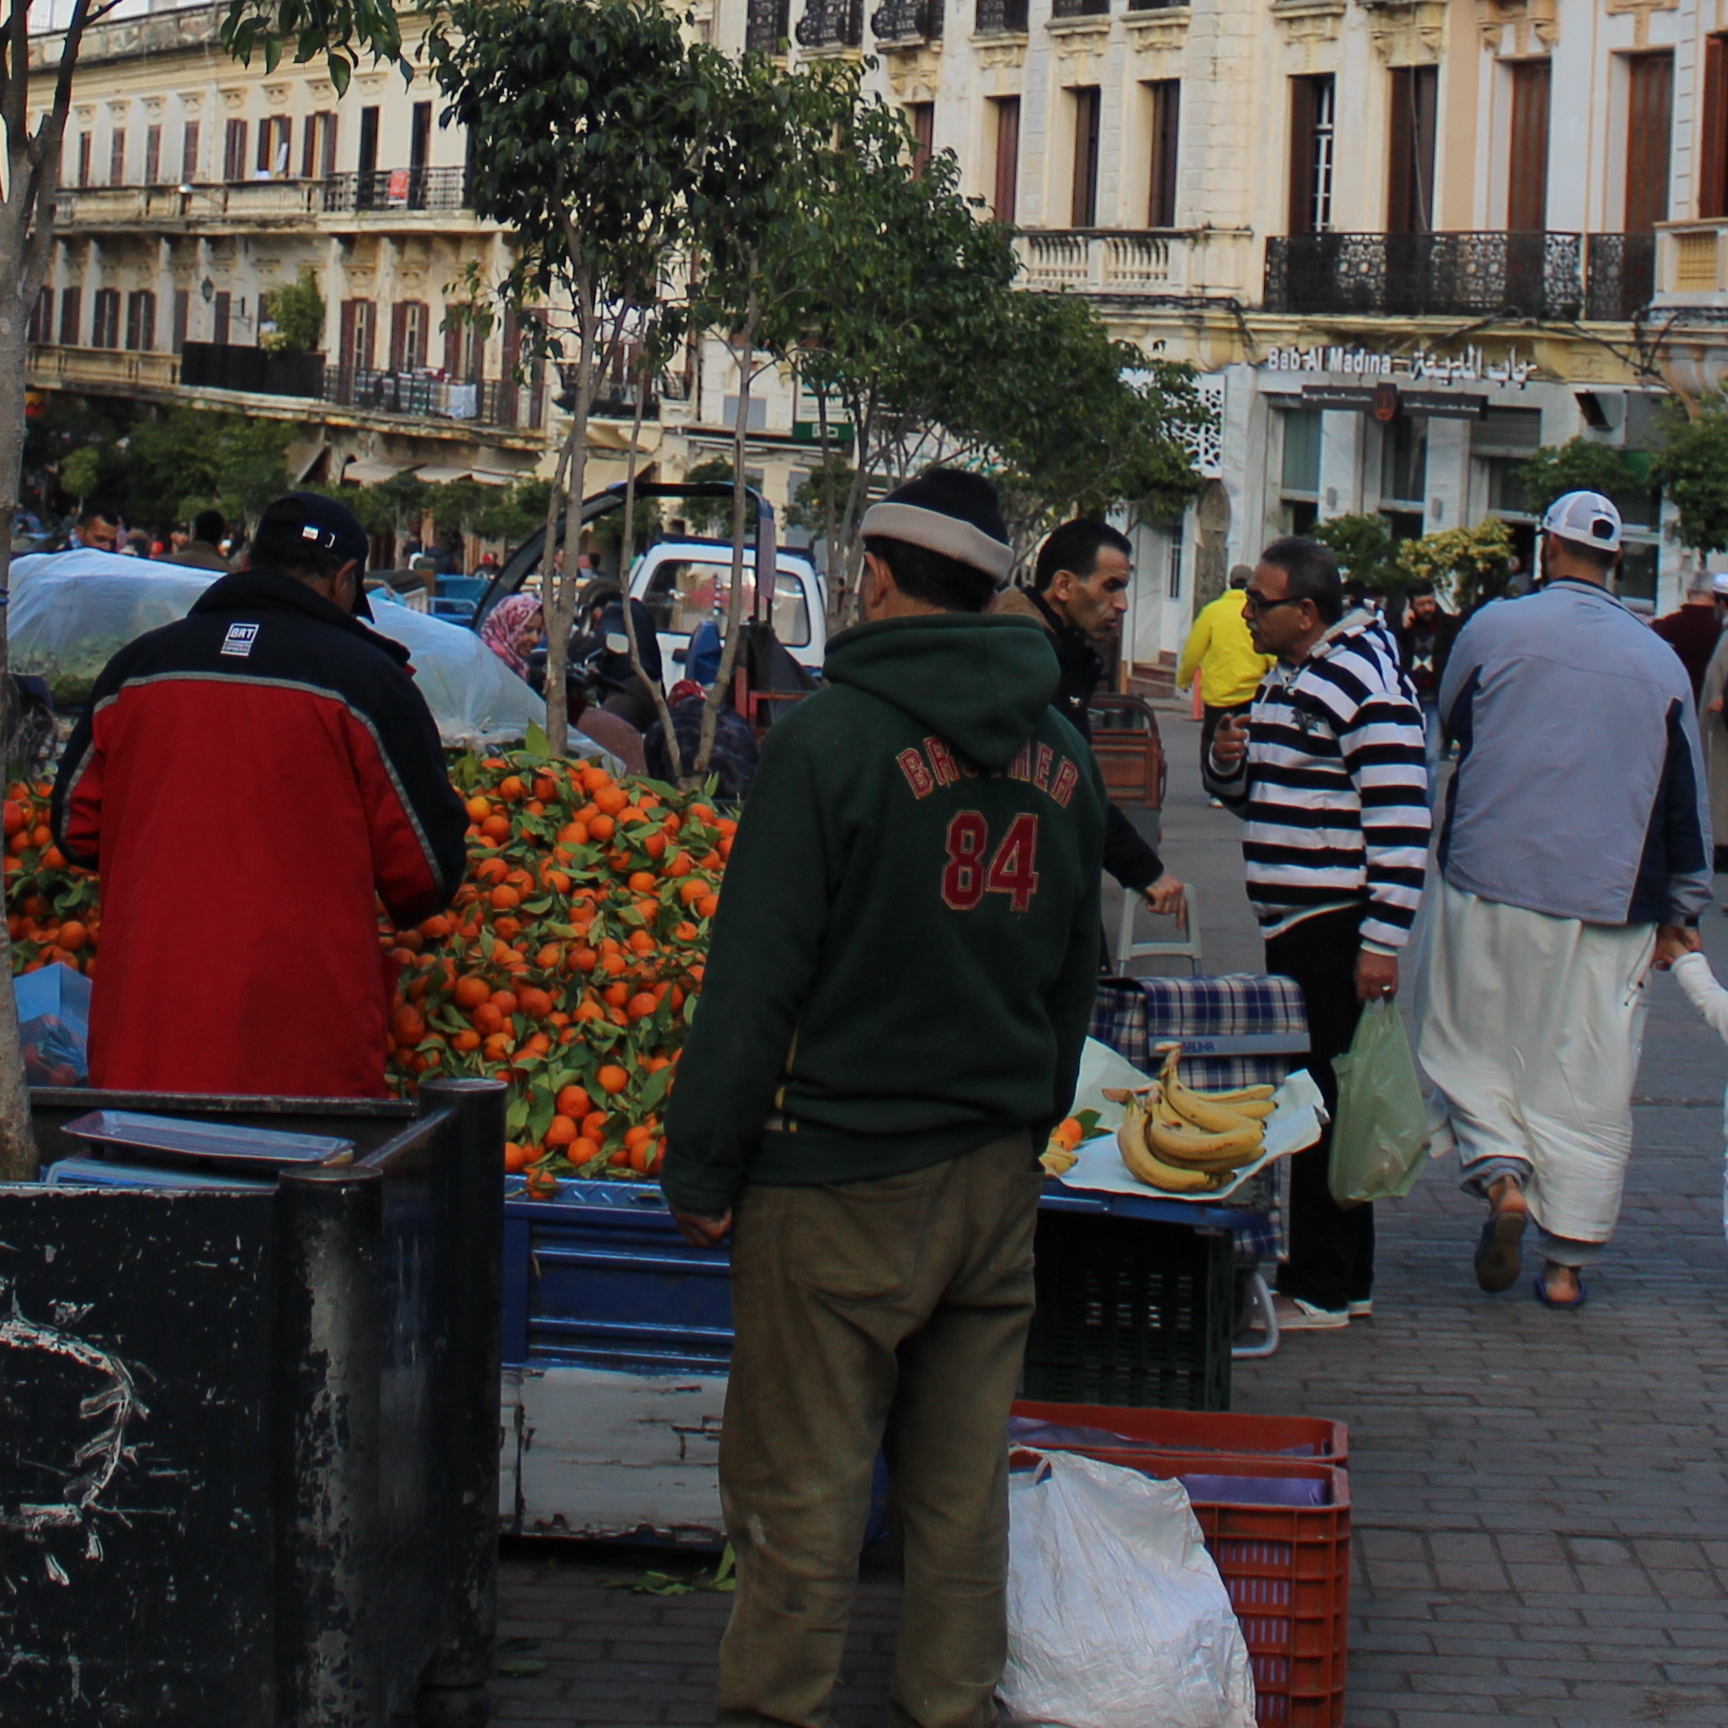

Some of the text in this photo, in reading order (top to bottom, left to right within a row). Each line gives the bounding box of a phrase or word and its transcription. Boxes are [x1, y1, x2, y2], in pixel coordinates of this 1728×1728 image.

[1268, 347, 1392, 374] Bab Al Madina
[1409, 343, 1538, 390] باب المدينة
[895, 736, 1080, 809] BRHER
[941, 810, 1040, 913] 84
